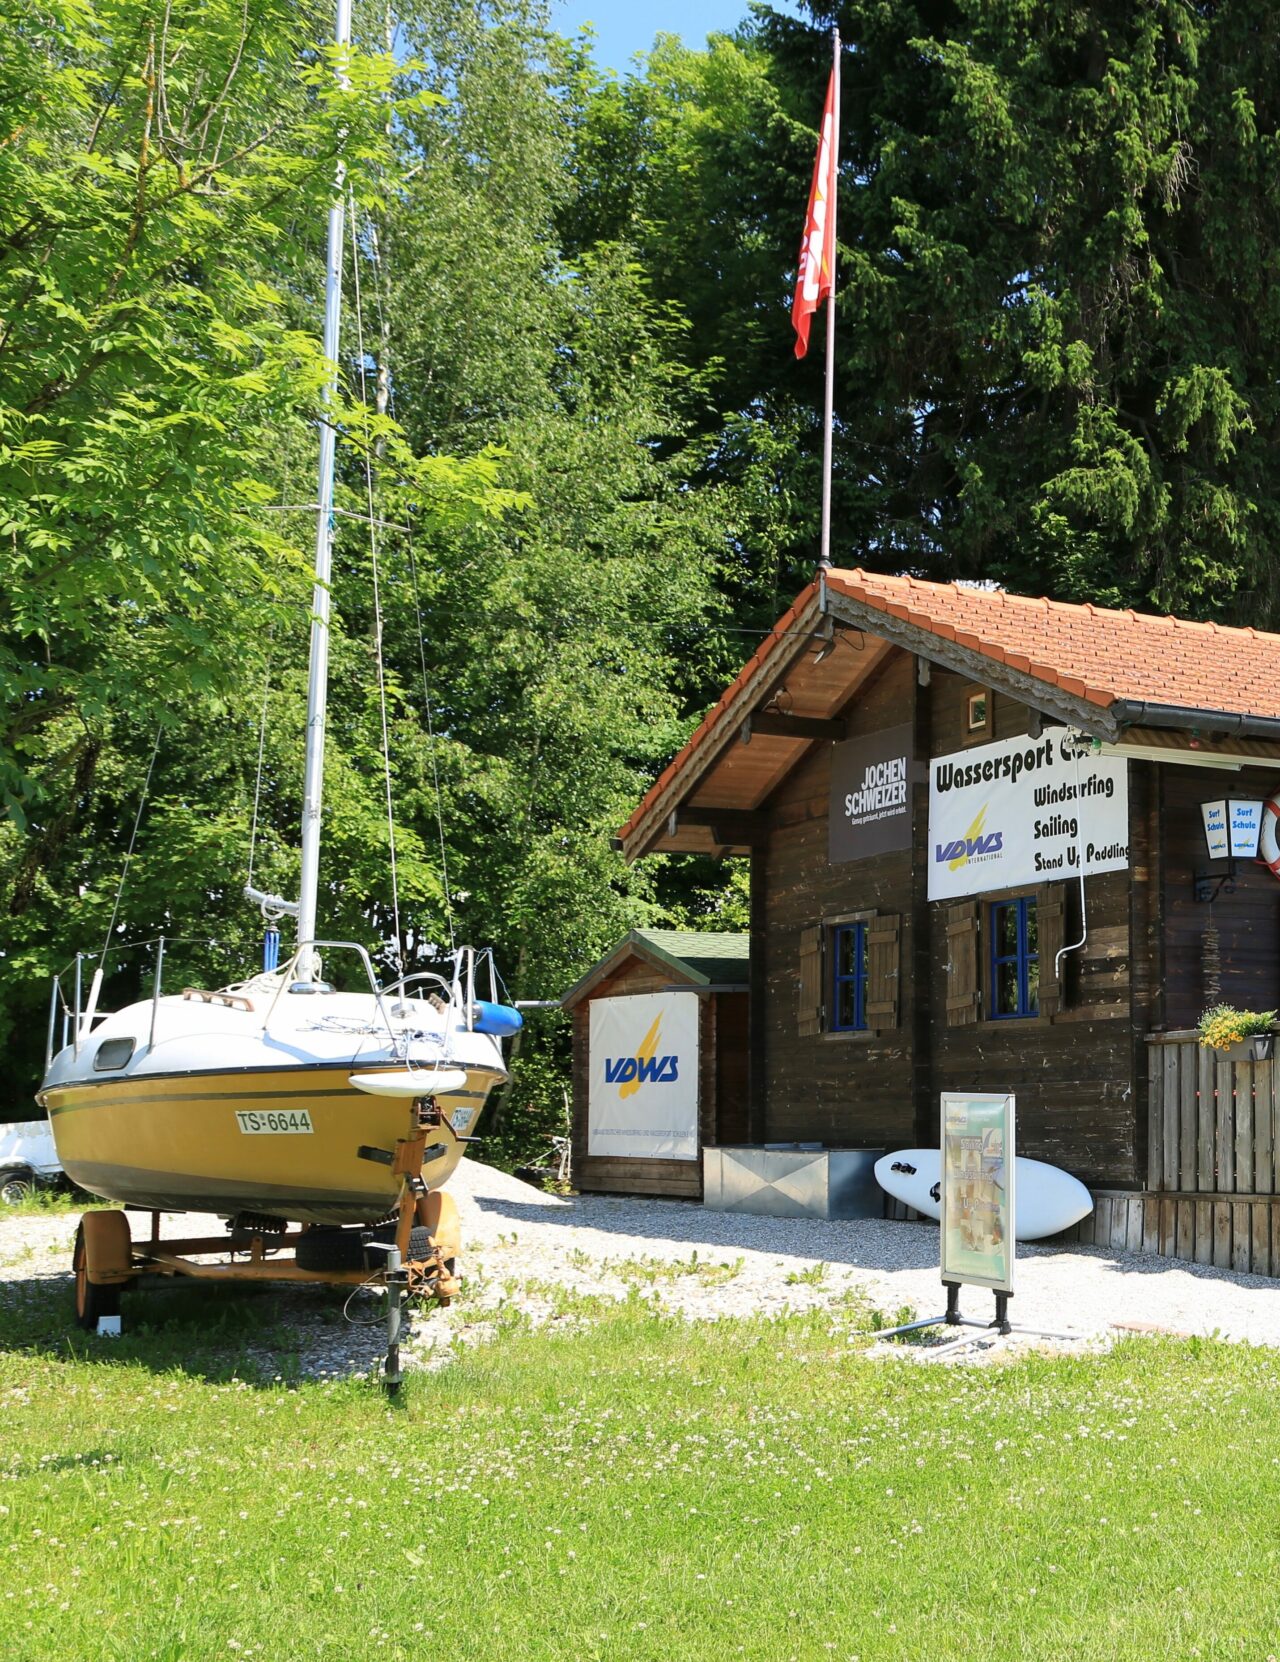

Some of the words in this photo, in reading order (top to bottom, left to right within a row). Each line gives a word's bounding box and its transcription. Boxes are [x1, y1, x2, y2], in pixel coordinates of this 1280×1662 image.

[861, 757, 906, 790] JOCHEN
[937, 739, 1053, 793] Wassersport
[845, 780, 907, 817] SCHWEIZER
[1034, 774, 1114, 807] Windsurfing
[1208, 809, 1220, 818] Surf
[1232, 820, 1256, 829] Schule
[1236, 808, 1253, 816] Surf
[1034, 814, 1078, 839] Sailing
[1207, 822, 1225, 831] Schule
[936, 832, 1003, 863] VDWS
[966, 853, 1003, 865] INTERNATIONAL
[1034, 852, 1063, 871] Stand
[605, 1056, 679, 1083] VDWS
